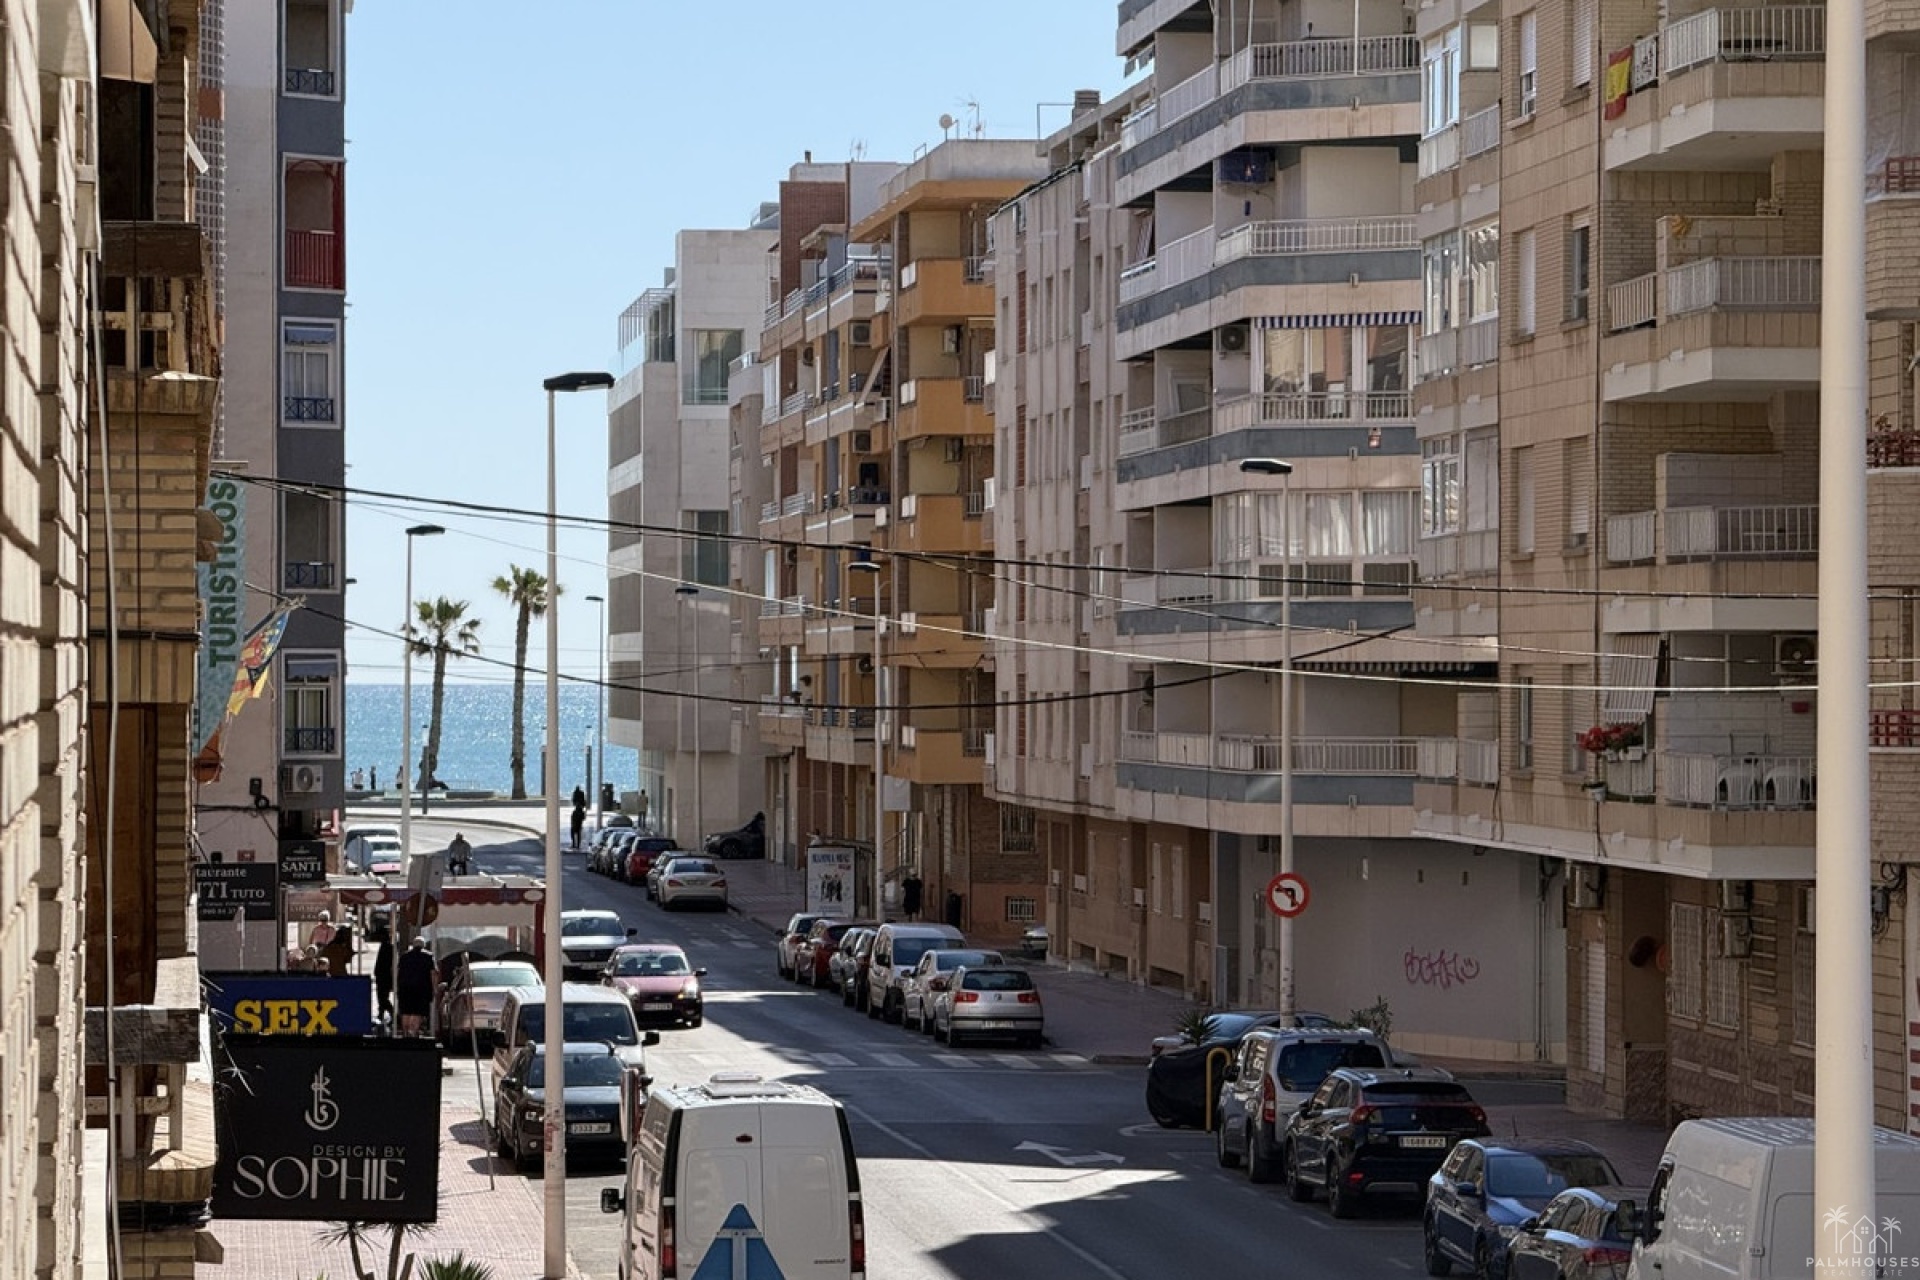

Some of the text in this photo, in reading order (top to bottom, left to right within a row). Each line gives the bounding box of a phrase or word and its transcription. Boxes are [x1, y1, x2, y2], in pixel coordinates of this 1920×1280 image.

[196, 868, 247, 878] taurante
[281, 861, 321, 873] SANTI
[230, 889, 265, 899] TUTO
[234, 999, 339, 1035] SEX
[313, 1145, 406, 1158] DESIGN BY
[232, 1155, 406, 1201] SOPHIE
